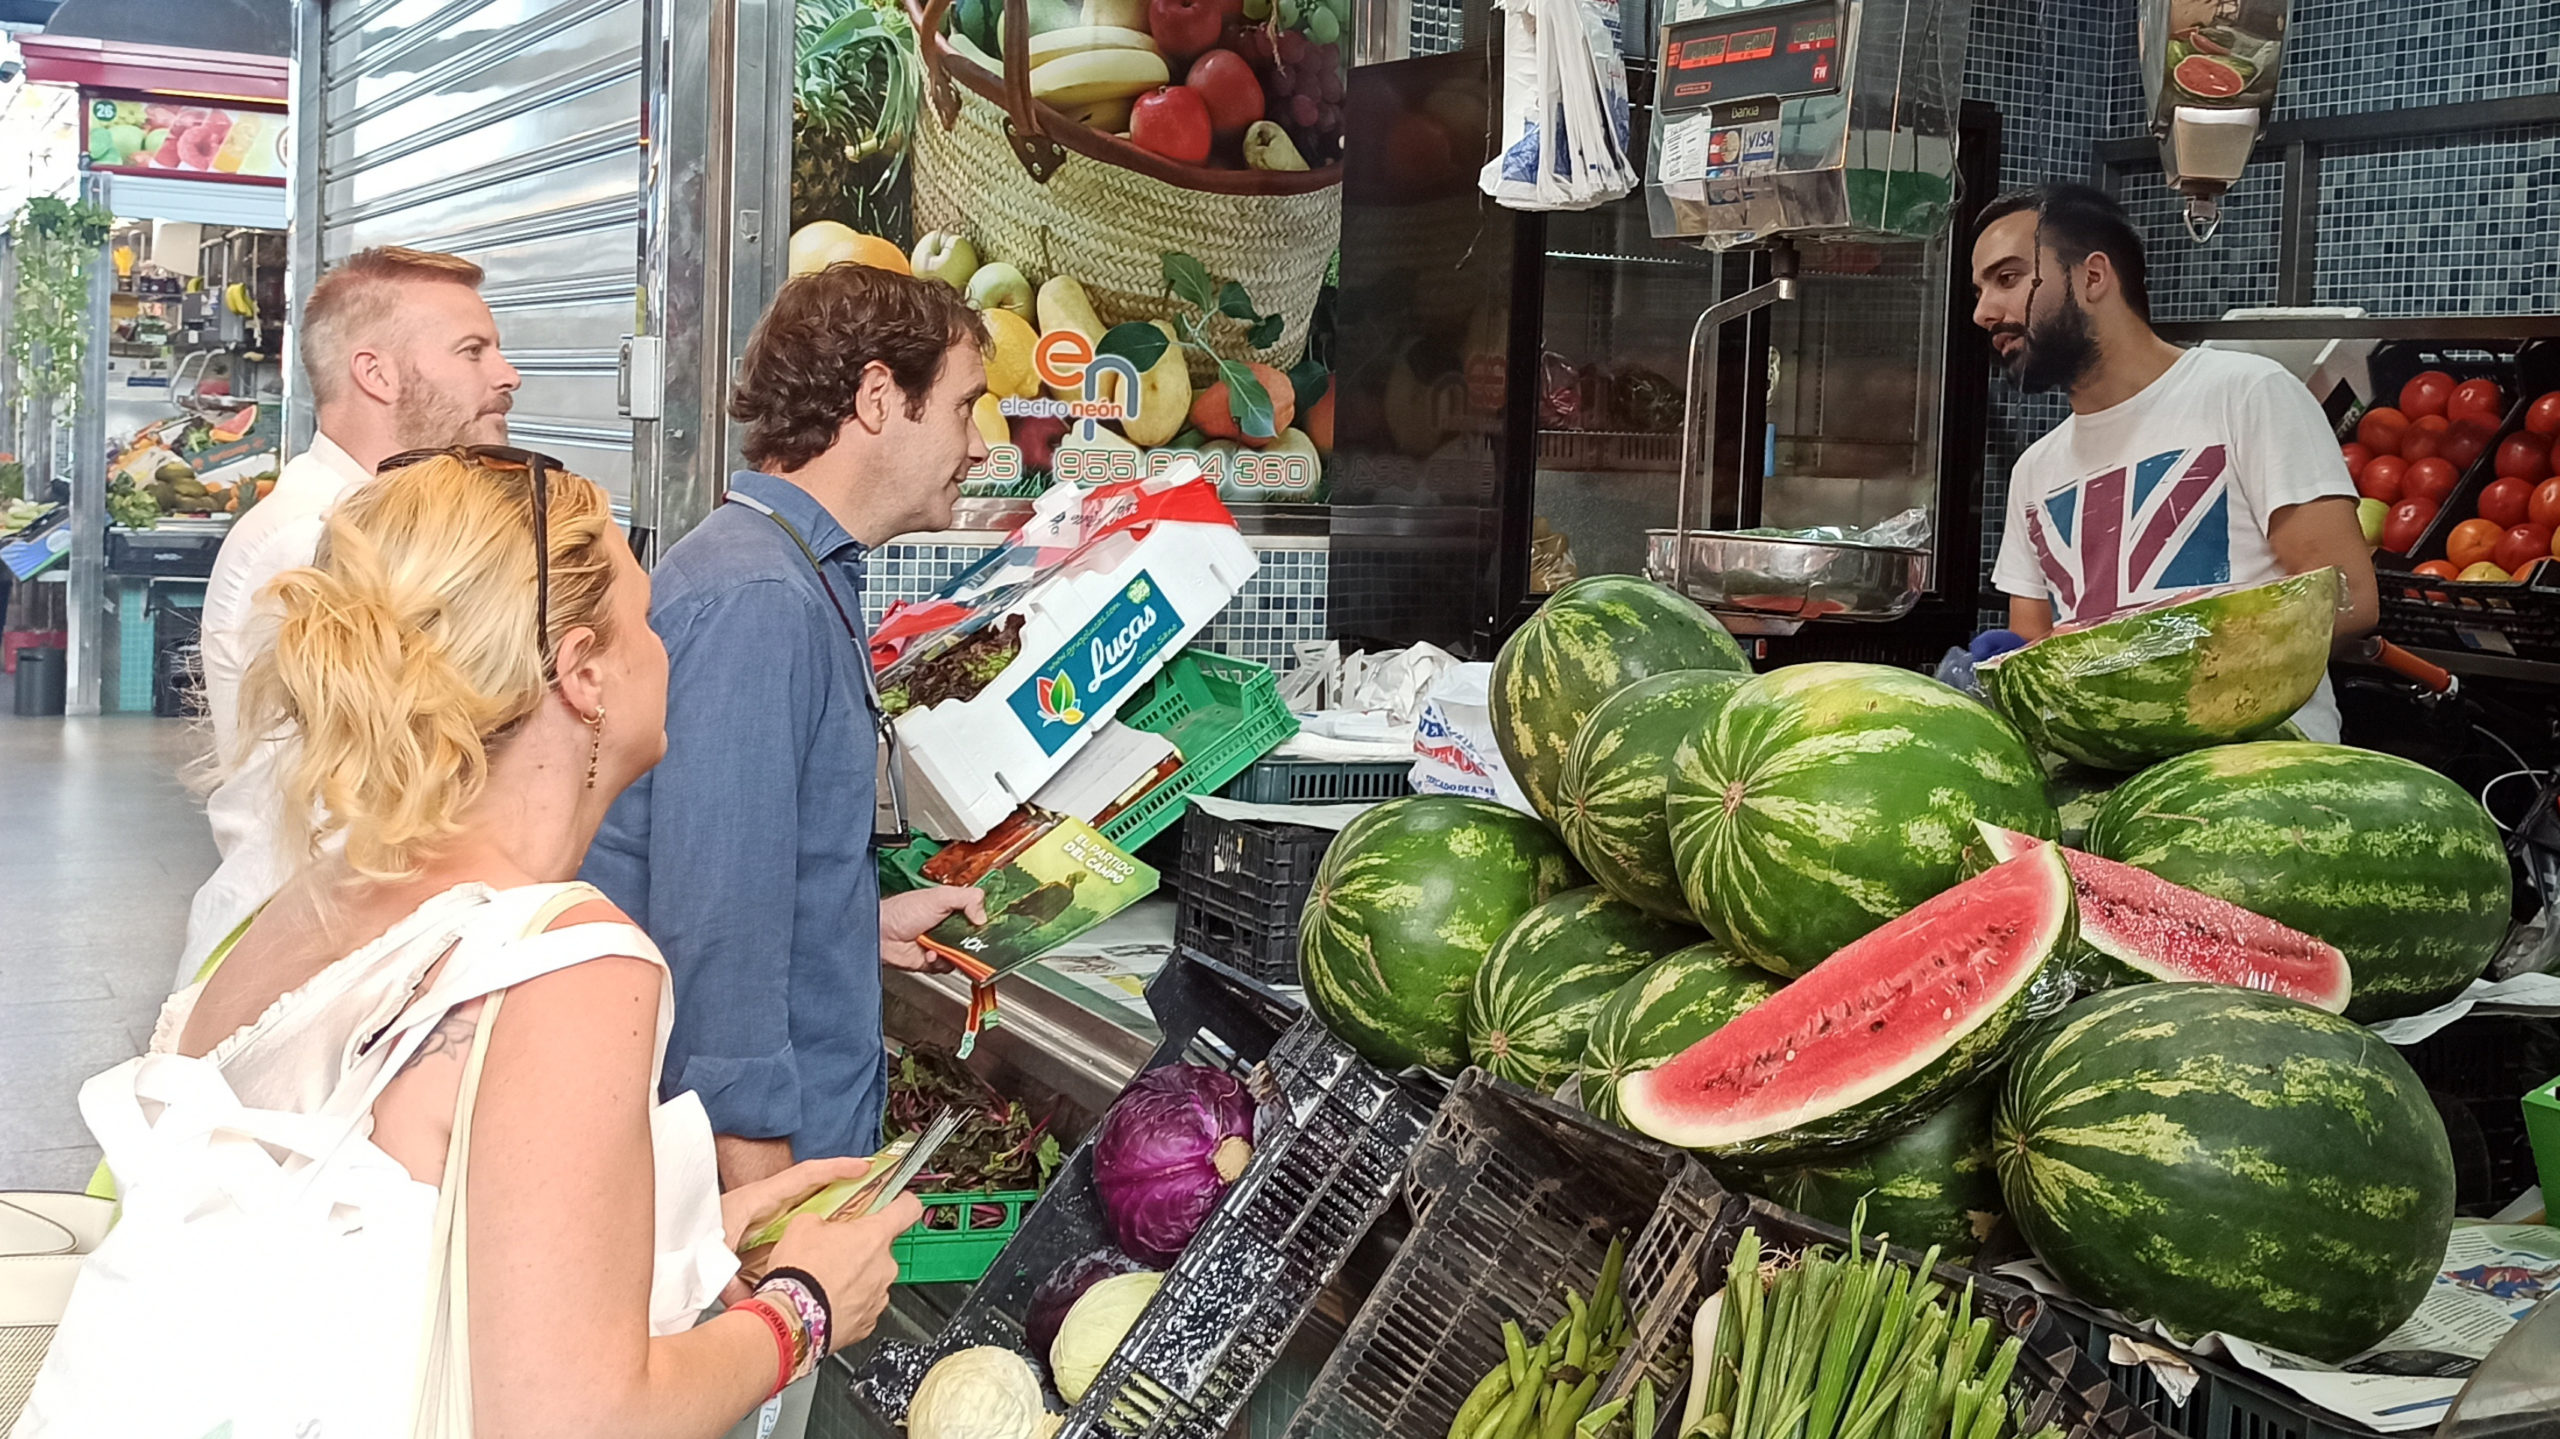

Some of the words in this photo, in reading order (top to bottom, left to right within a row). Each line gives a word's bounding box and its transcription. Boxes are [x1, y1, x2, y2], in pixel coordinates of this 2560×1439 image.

[1814, 67, 1827, 79] FW
[95, 104, 114, 118] 26
[1749, 131, 1774, 148] VISA
[1056, 450, 1137, 484] 955
[1147, 450, 1224, 486] 64
[1234, 453, 1308, 488] 360
[1087, 604, 1157, 693] Lucas
[1062, 840, 1087, 863] DEL
[1084, 856, 1126, 885] CAMPO
[1074, 833, 1091, 848] EL
[1088, 843, 1136, 876] PARTIDO
